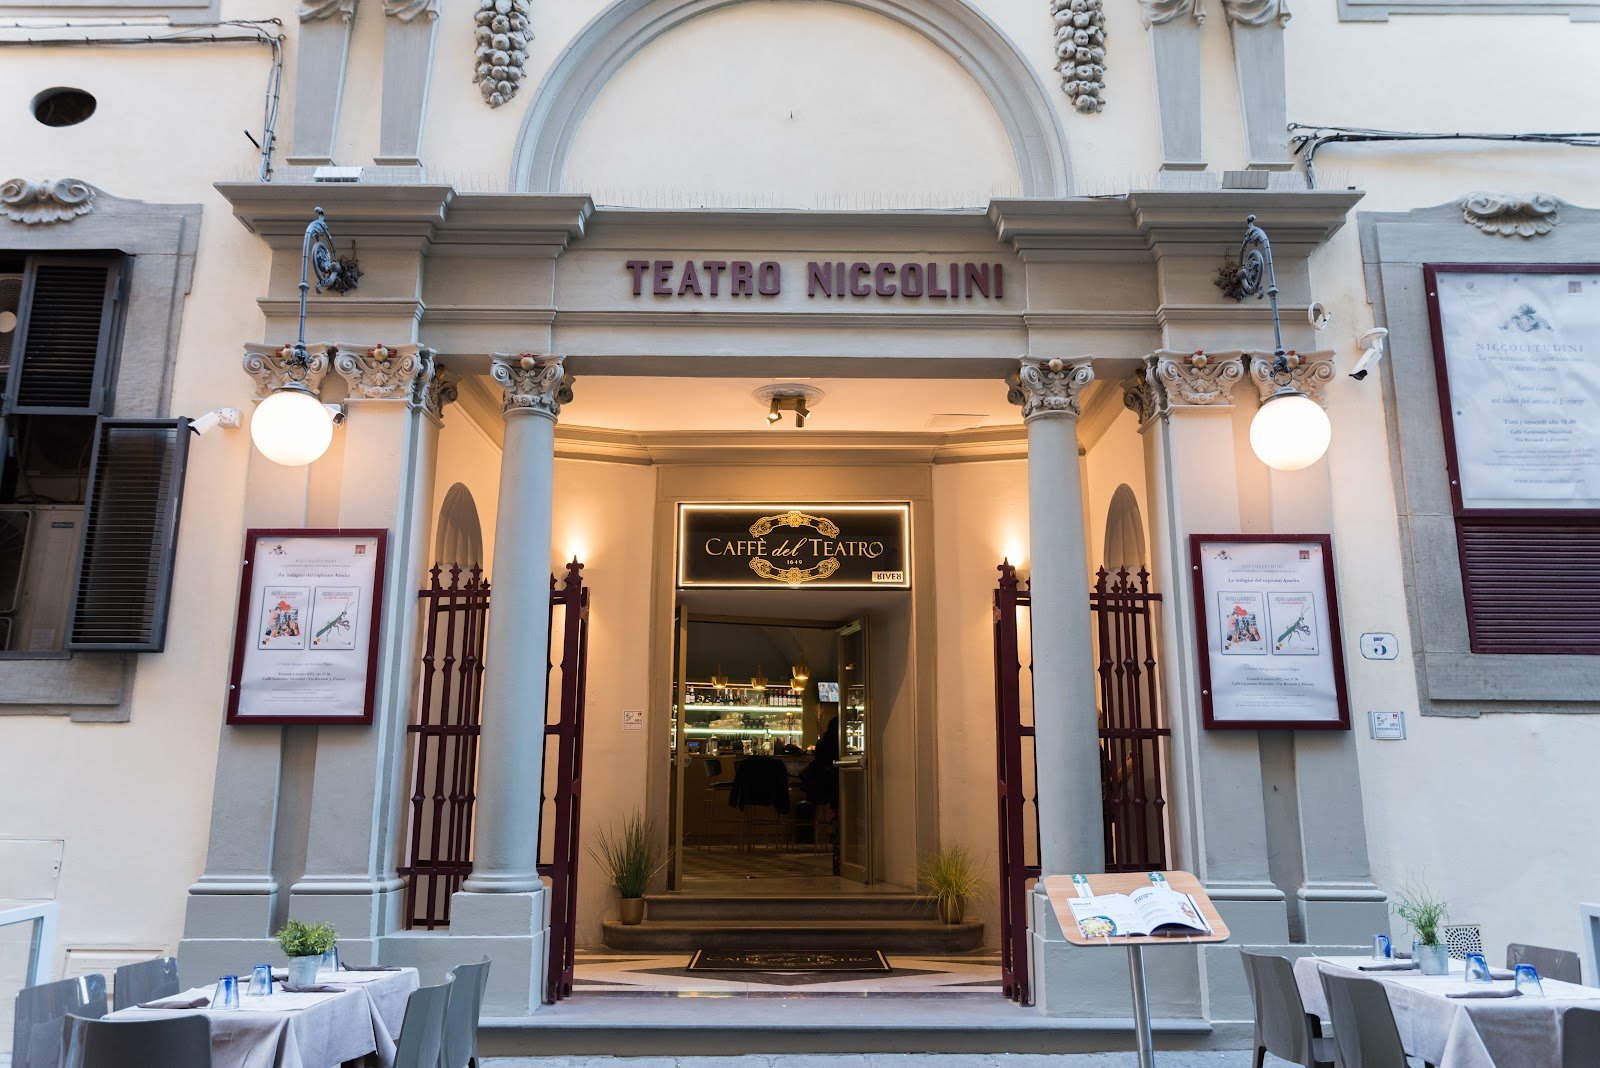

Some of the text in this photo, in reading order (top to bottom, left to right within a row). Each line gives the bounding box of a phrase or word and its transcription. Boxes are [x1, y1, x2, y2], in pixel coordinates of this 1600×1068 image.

[626, 259, 1003, 299] TEATRO NICCOLINI
[705, 537, 884, 559] CAFFÈ del TEATRO
